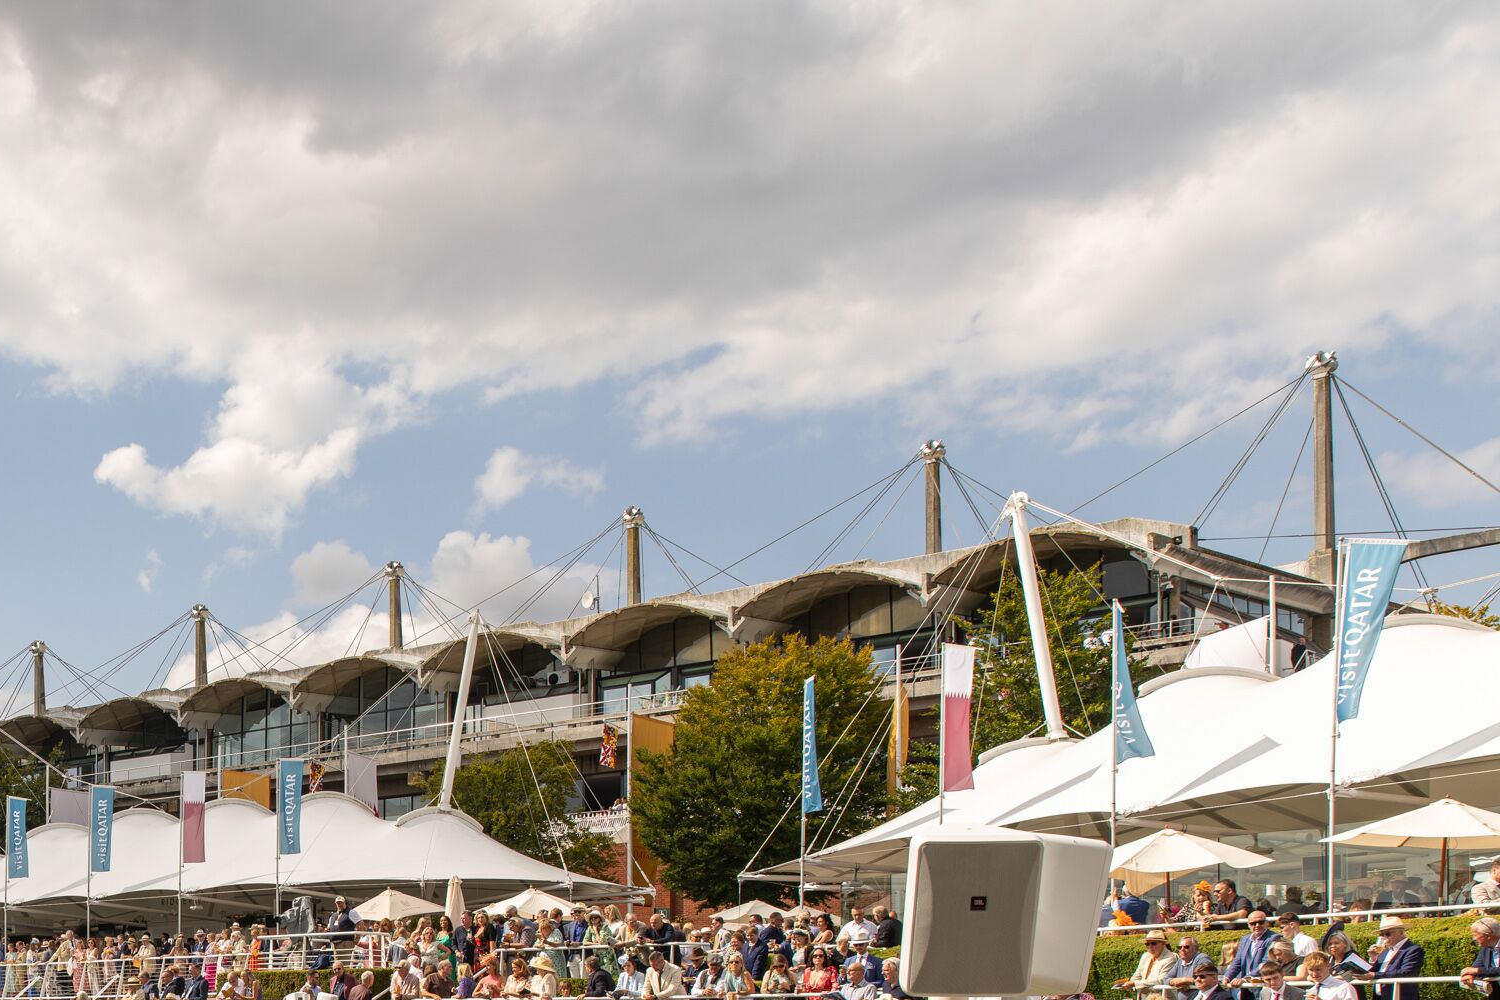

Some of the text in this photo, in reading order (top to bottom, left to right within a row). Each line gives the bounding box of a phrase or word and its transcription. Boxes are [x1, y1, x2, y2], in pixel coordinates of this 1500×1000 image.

[1337, 566, 1382, 705] visitQATAR
[15, 810, 23, 871] visitQATAR
[97, 799, 108, 864] visitQATAR
[285, 774, 297, 845] visitQATAR
